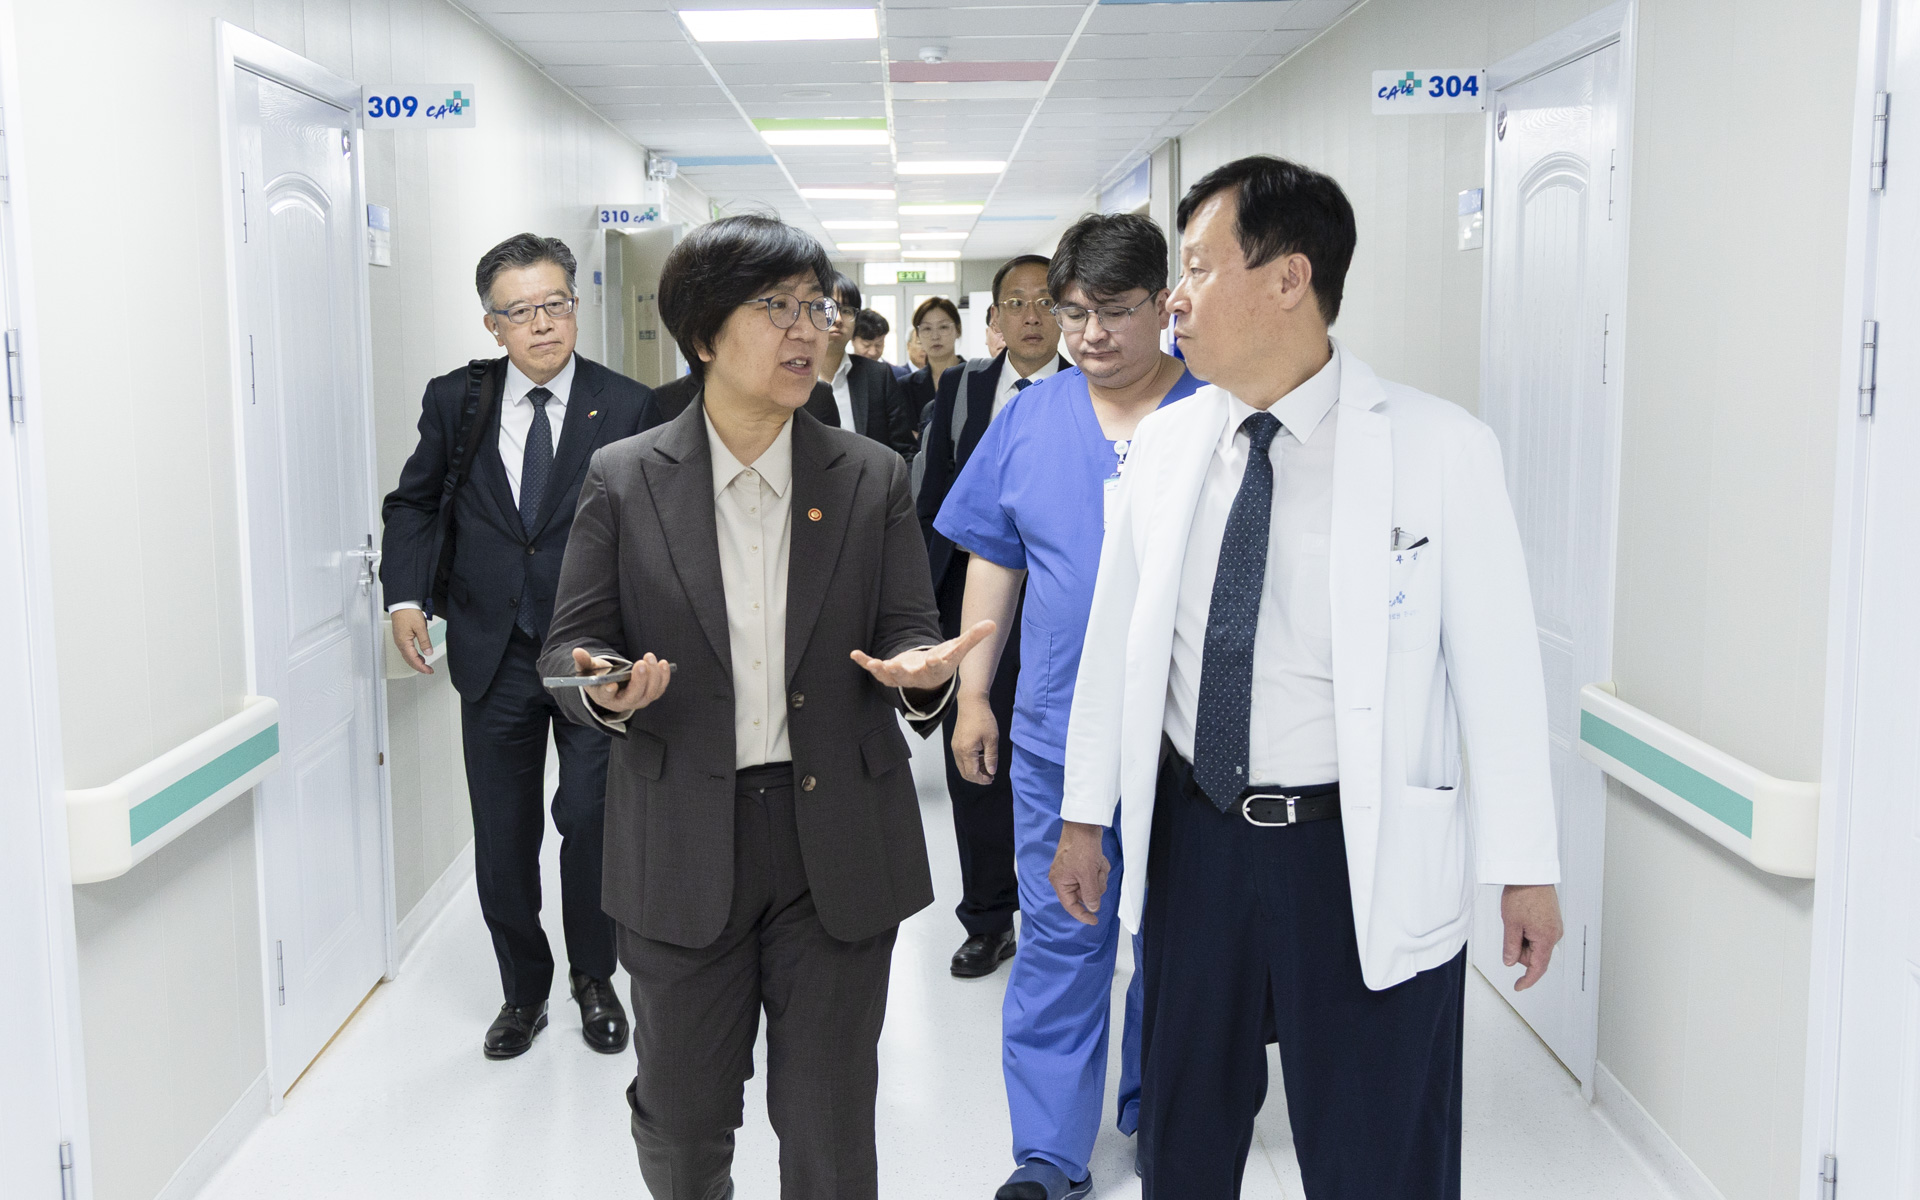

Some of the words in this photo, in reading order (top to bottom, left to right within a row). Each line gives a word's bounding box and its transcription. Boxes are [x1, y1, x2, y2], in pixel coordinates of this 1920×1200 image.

[1428, 75, 1480, 99] 304
[367, 95, 419, 119] 309
[602, 210, 630, 223] 310
[898, 272, 924, 280] EXIT
